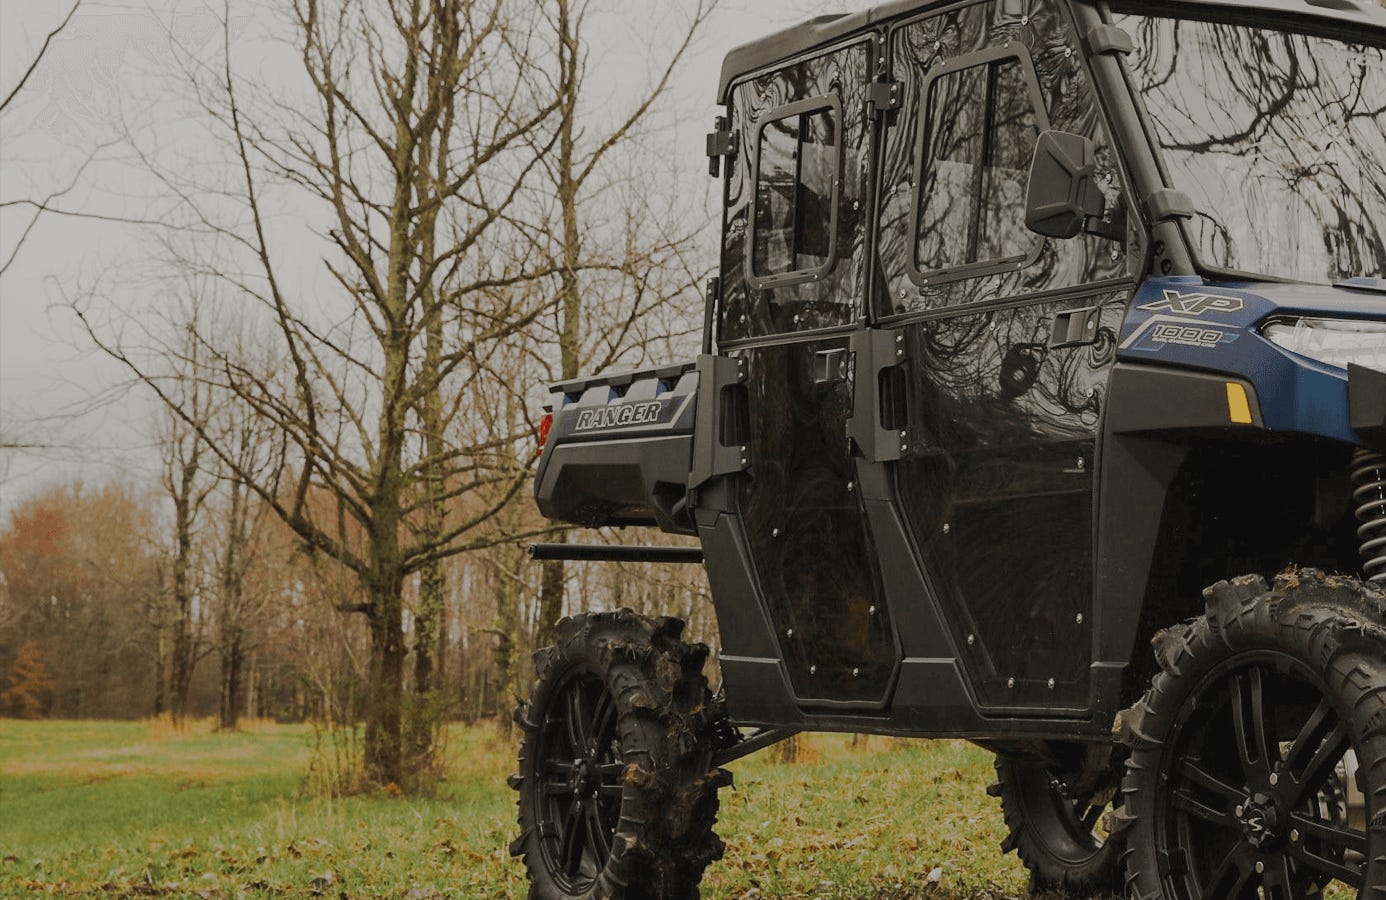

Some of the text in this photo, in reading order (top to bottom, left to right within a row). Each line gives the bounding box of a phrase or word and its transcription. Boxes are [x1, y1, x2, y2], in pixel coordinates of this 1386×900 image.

[1136, 289, 1243, 315] XP
[1152, 324, 1223, 343] 1000
[575, 401, 662, 430] RANGER
